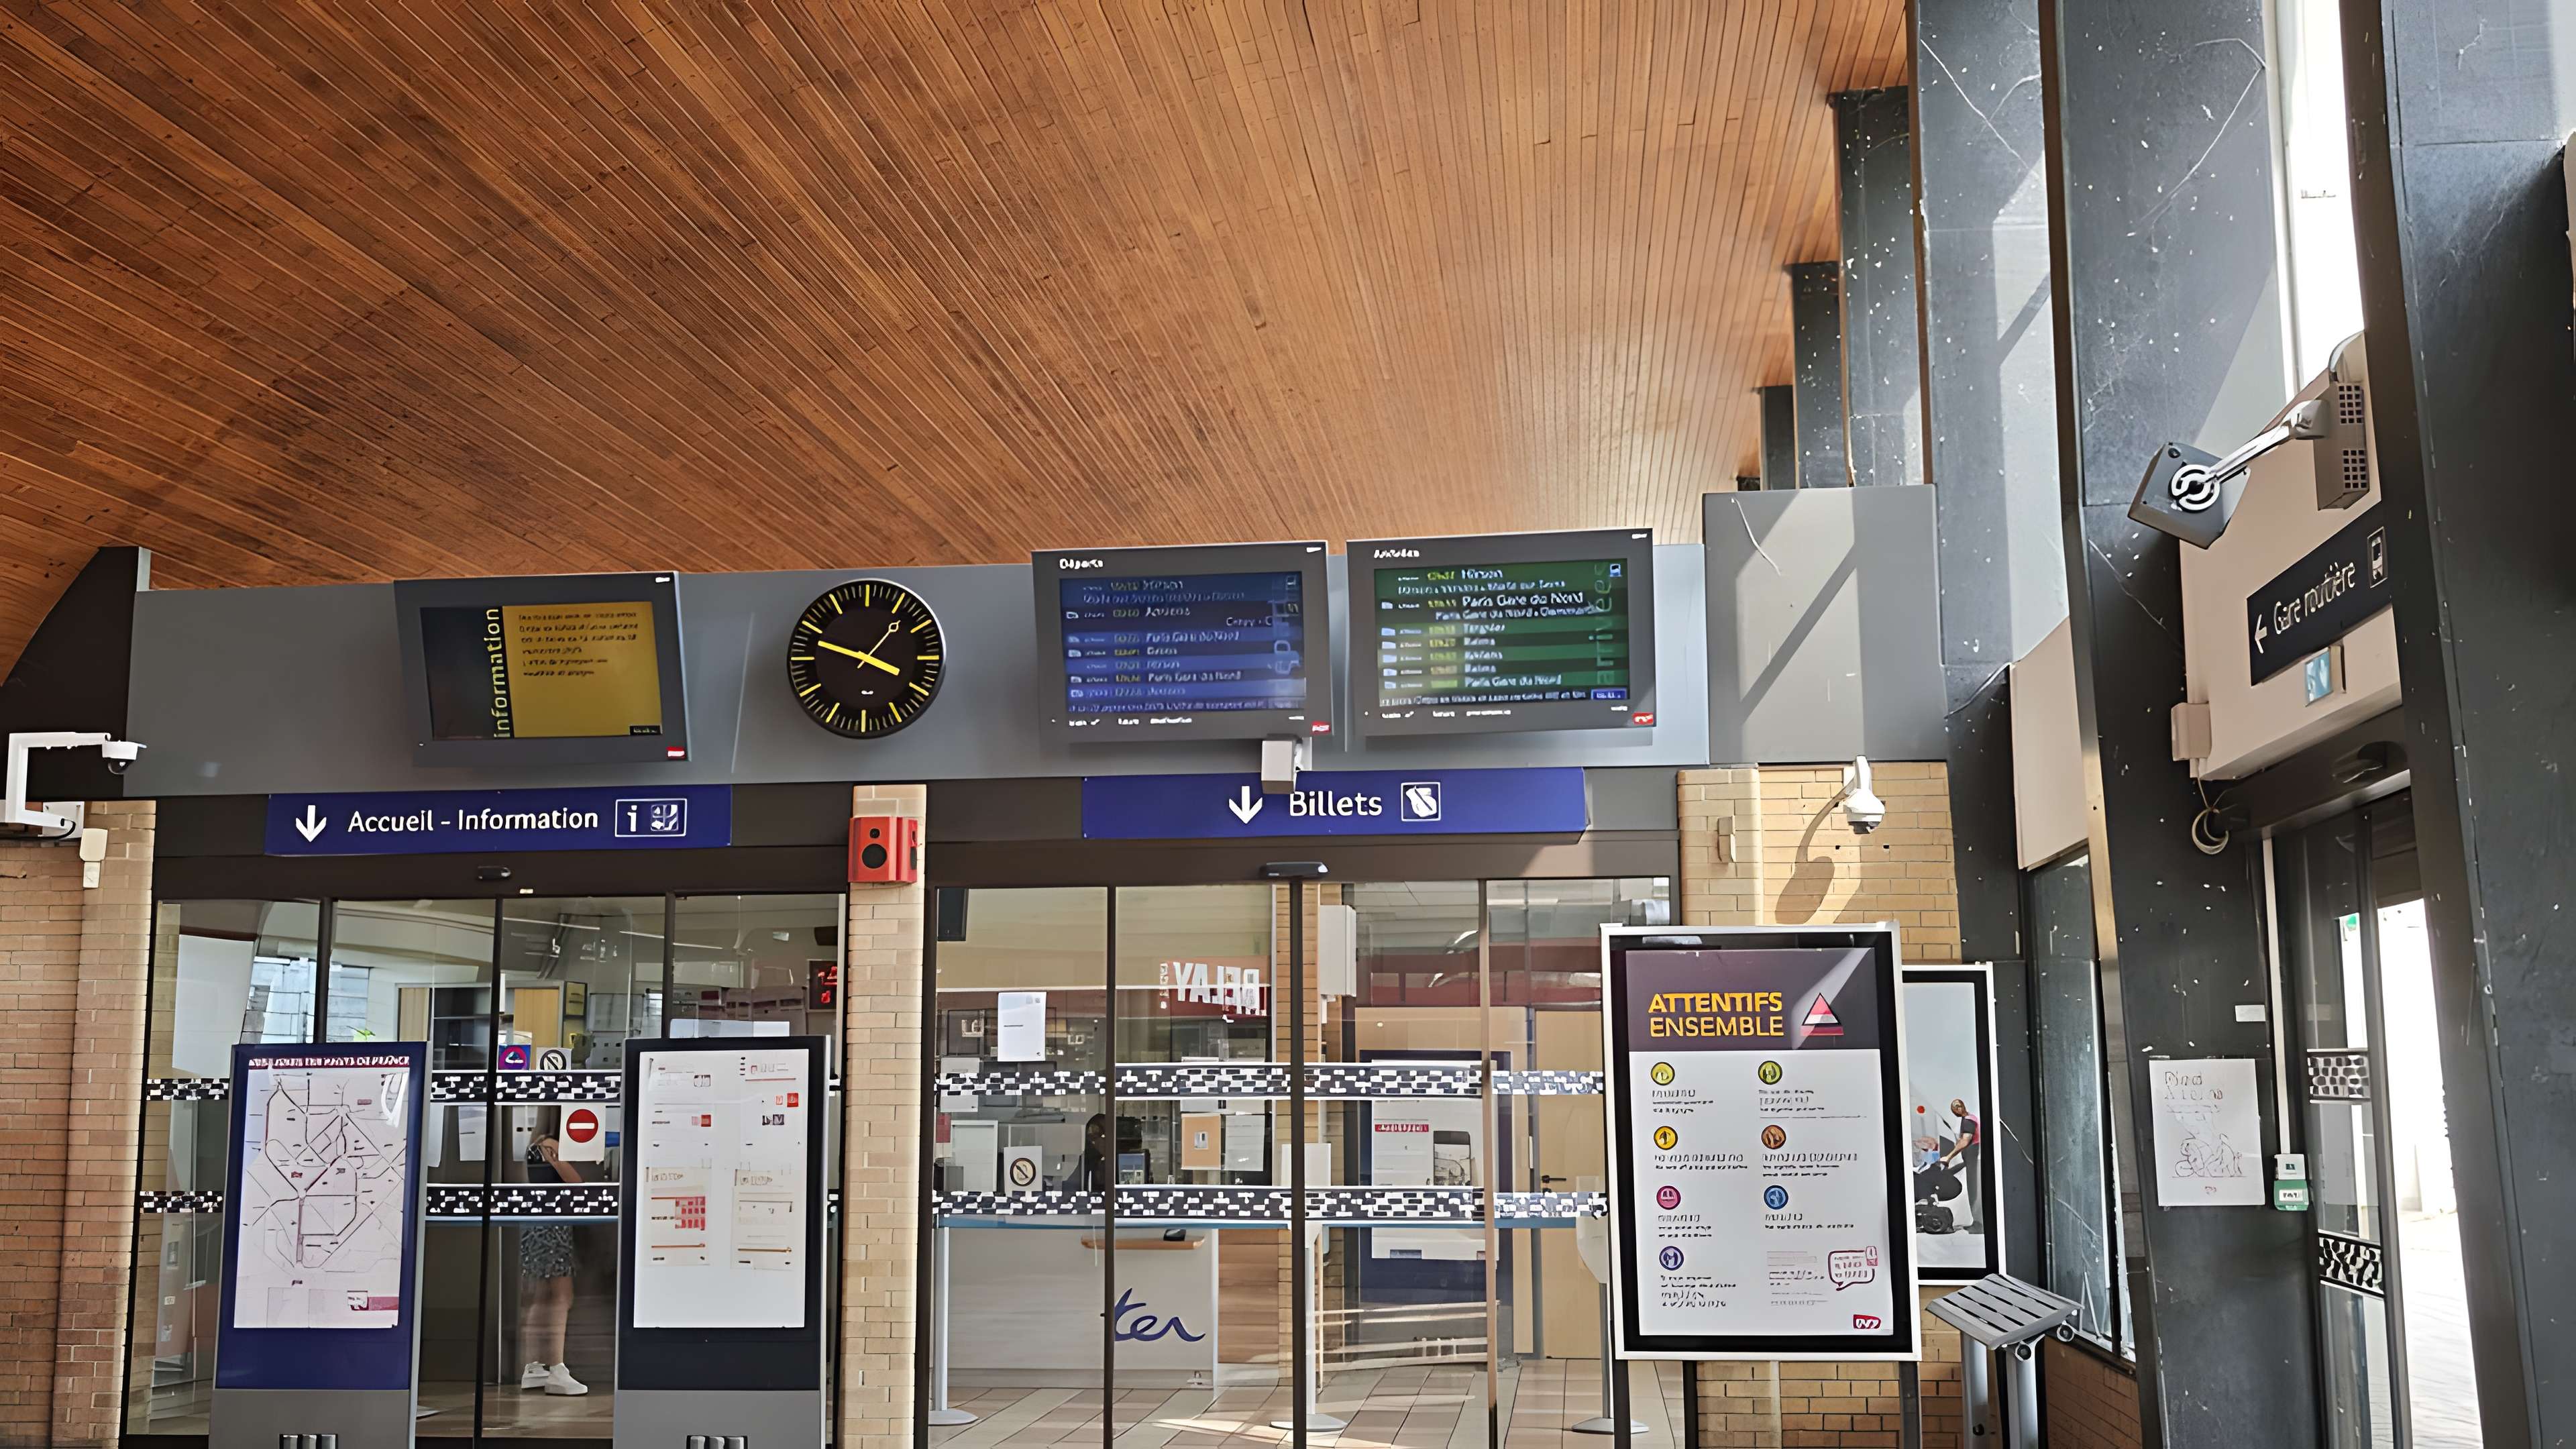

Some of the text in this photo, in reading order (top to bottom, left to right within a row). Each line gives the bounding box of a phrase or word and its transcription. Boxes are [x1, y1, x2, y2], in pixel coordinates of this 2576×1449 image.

[2273, 561, 2355, 635] Gare routière
[483, 608, 511, 739] information
[1289, 790, 1383, 817] Billets
[347, 809, 433, 833] Accueil
[458, 807, 599, 831] Information
[1648, 991, 1783, 1014] ATTENTIFS
[1650, 1015, 1785, 1037] ENSEMBLE
[1100, 1287, 1205, 1342] ter
